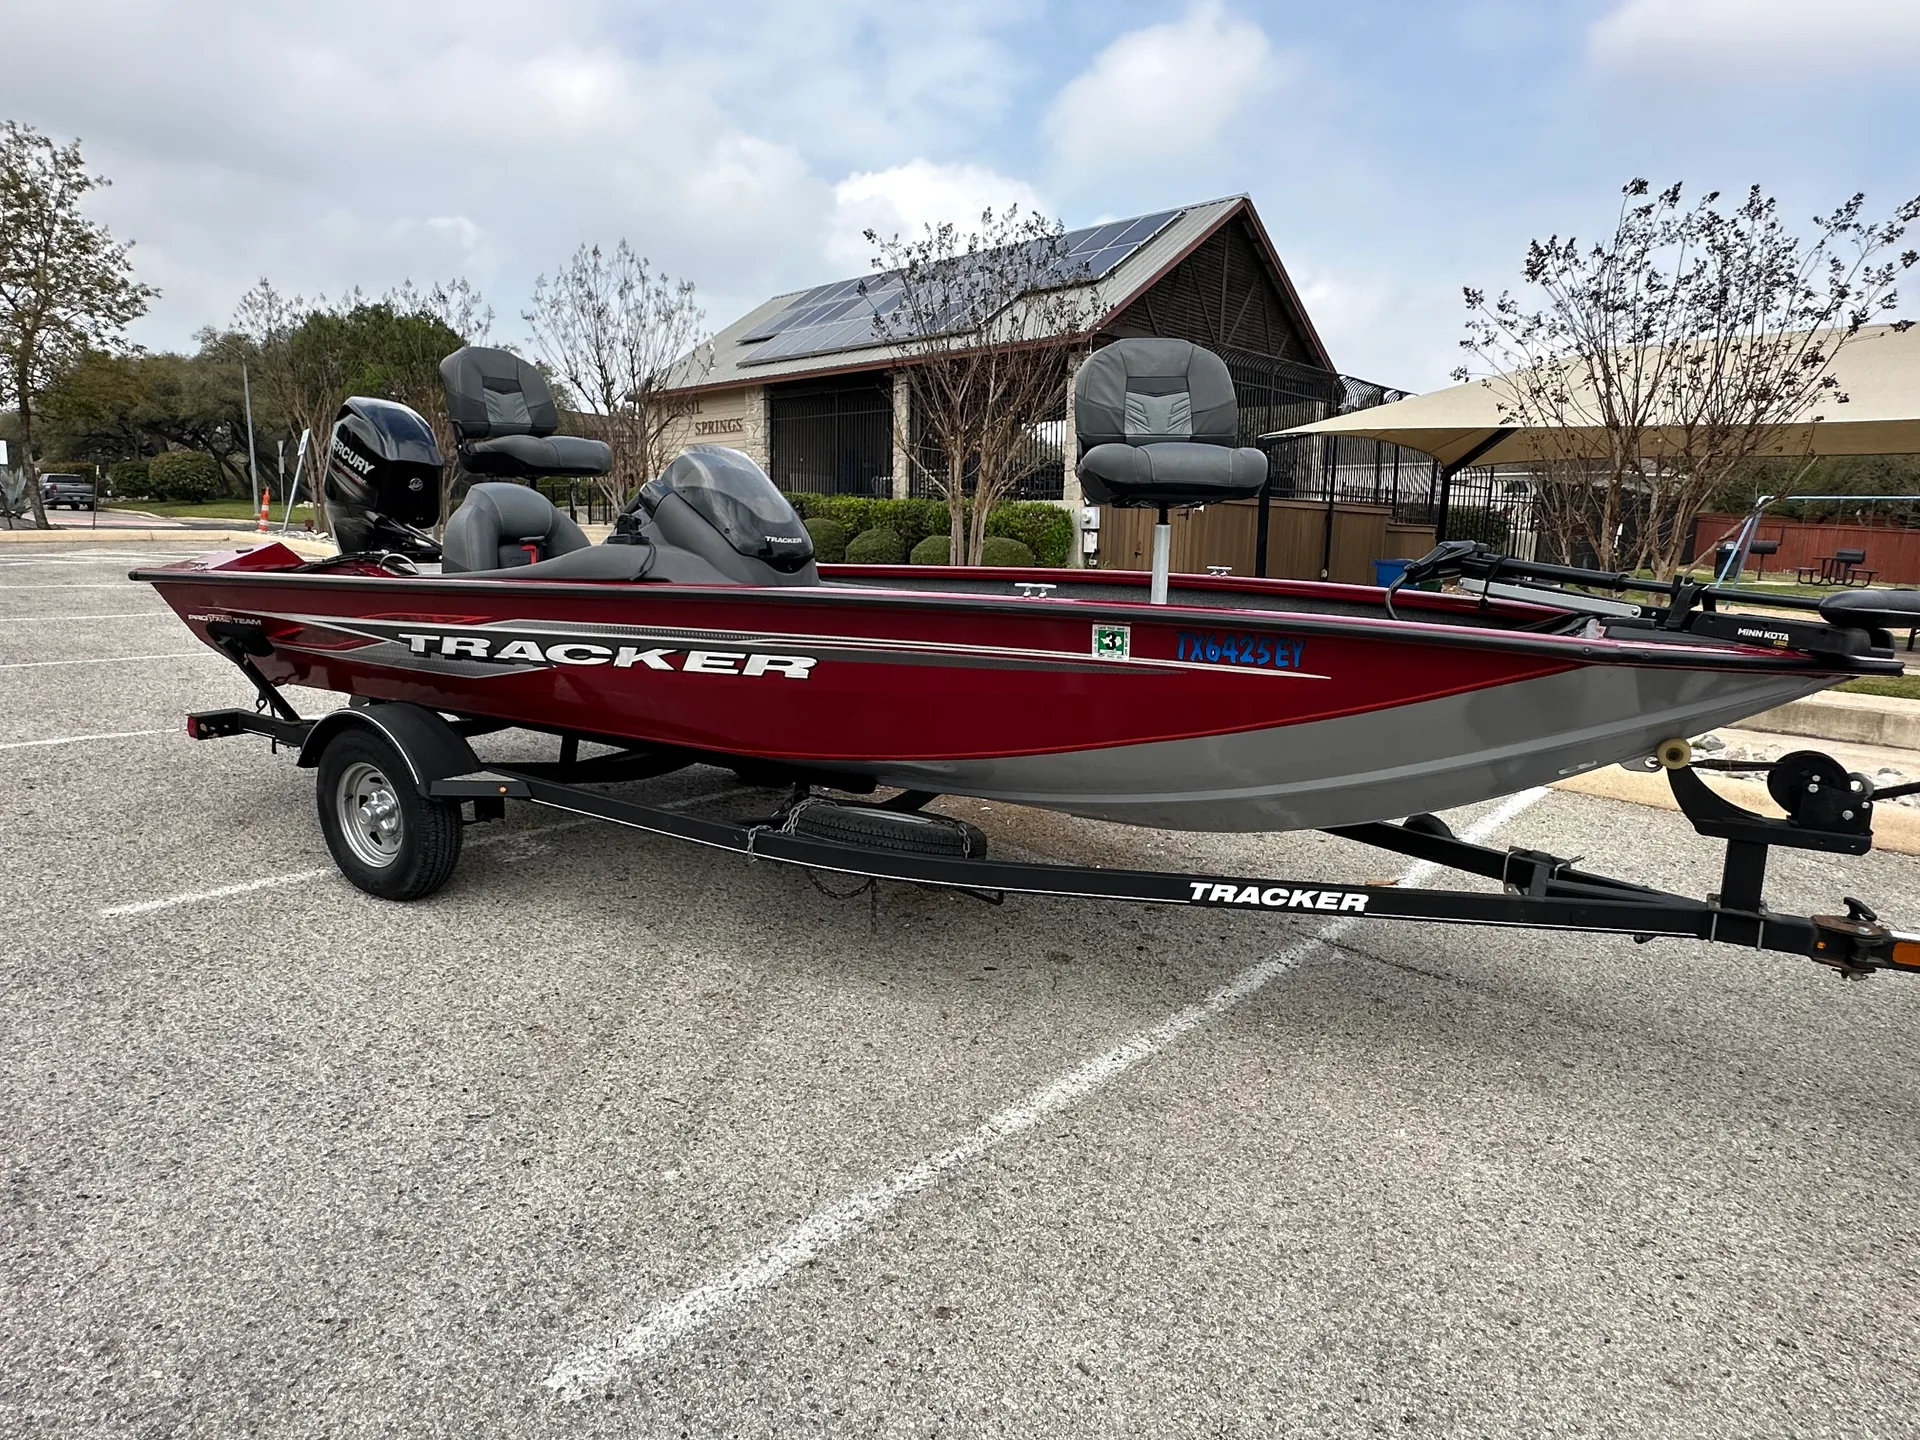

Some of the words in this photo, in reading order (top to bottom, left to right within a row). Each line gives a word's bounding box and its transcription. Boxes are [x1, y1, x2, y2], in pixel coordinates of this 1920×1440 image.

[695, 417, 744, 436] SPRINGS
[331, 435, 376, 475] ERCURY
[764, 535, 803, 544] TRACKER
[233, 617, 262, 626] TEAM
[1104, 630, 1117, 651] 3
[1737, 627, 1763, 638] MINN
[1763, 630, 1789, 641] KOTA
[397, 632, 819, 680] TRACKER
[1176, 631, 1305, 668] TX6425EY
[1189, 882, 1370, 912] TRACKER
